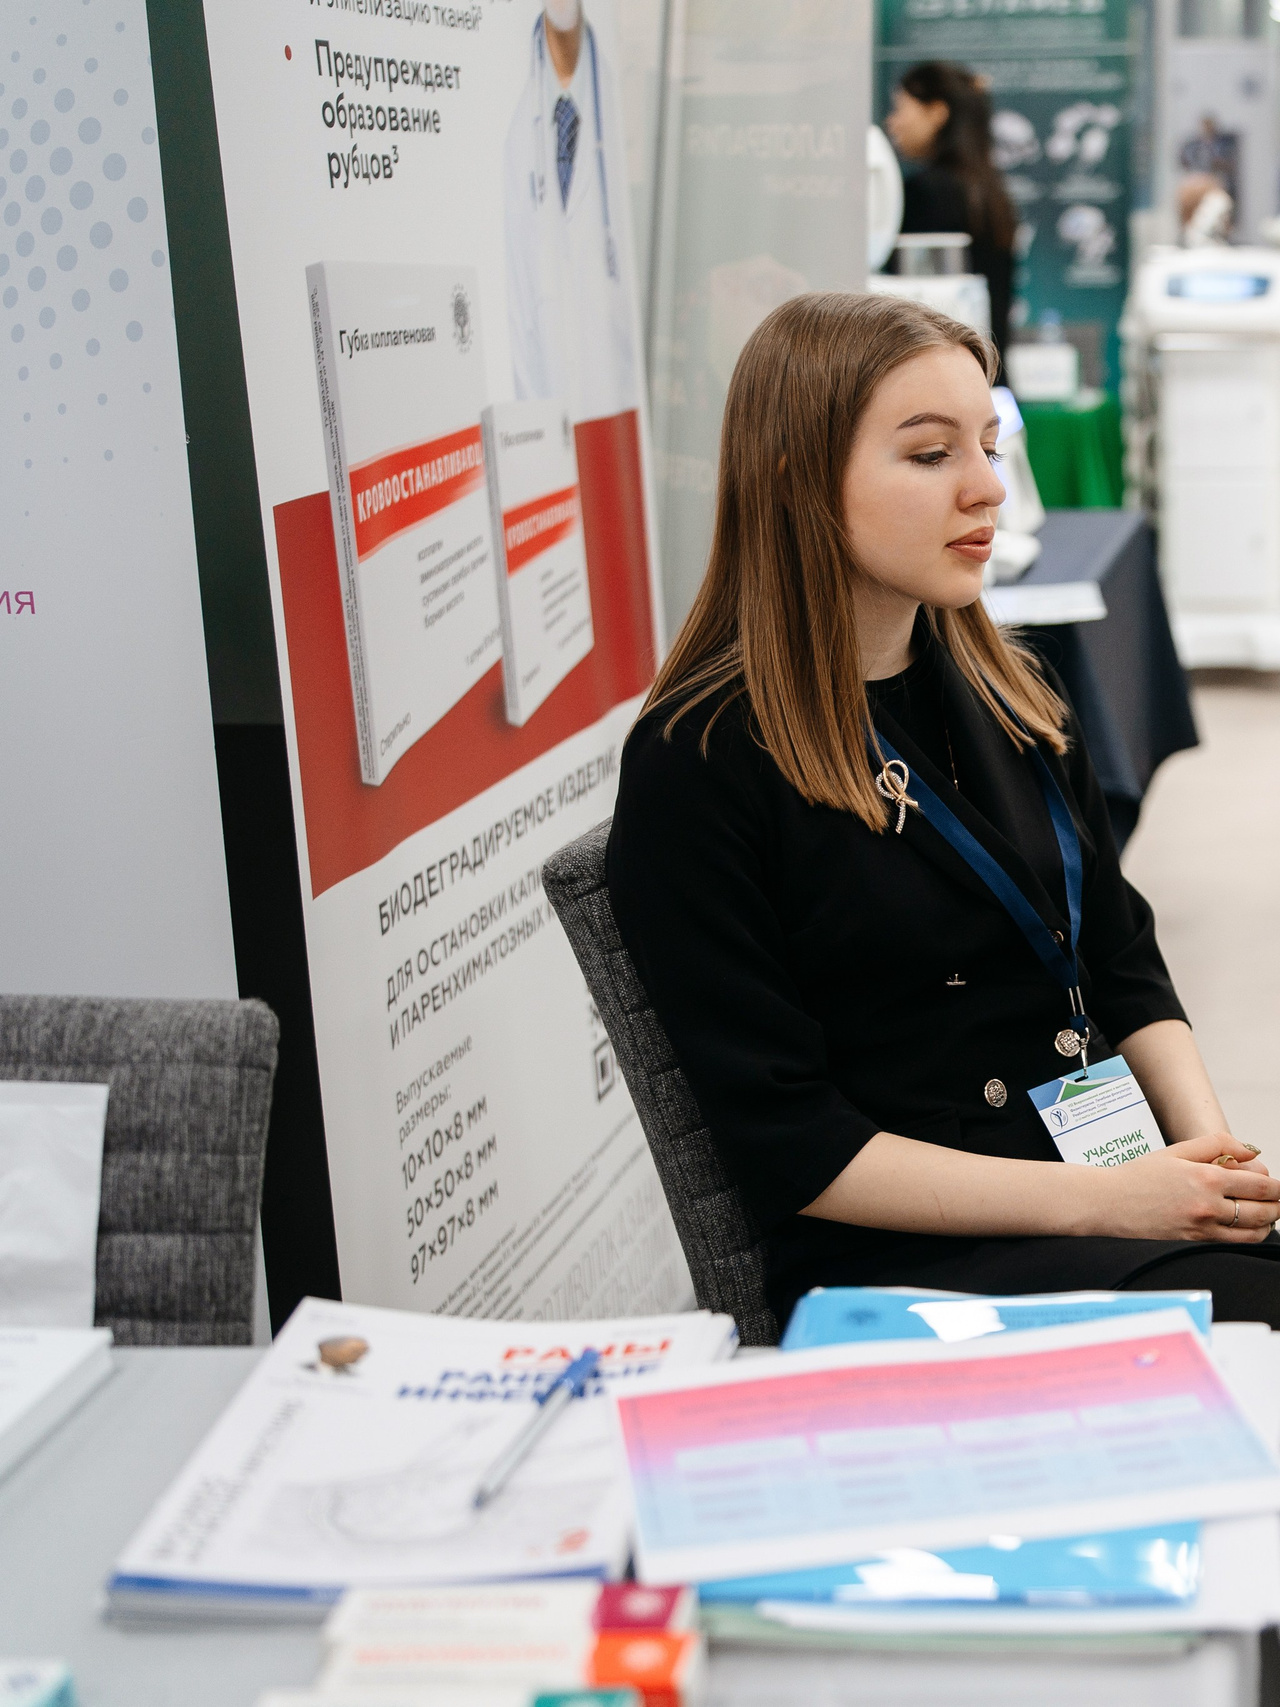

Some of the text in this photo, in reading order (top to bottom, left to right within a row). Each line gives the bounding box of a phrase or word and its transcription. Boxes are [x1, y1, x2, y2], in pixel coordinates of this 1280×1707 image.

[314, 38, 462, 93] Предупреждает
[321, 93, 441, 134] образование
[326, 144, 400, 189] рубцов³
[338, 326, 436, 360] Губка коллагеновая
[378, 786, 557, 938] БИОДЕГРАДИРУЕМОЕ
[386, 960, 414, 1012] ДЛЯ
[417, 896, 507, 977] ОСТАНОВКИ
[388, 912, 547, 1052] И ПАРЕНХИМАТОЗНЫХ
[395, 1034, 473, 1115] Выпускаемые
[399, 1083, 453, 1151] размеры:
[1082, 1129, 1146, 1163] УЧАСТНИК
